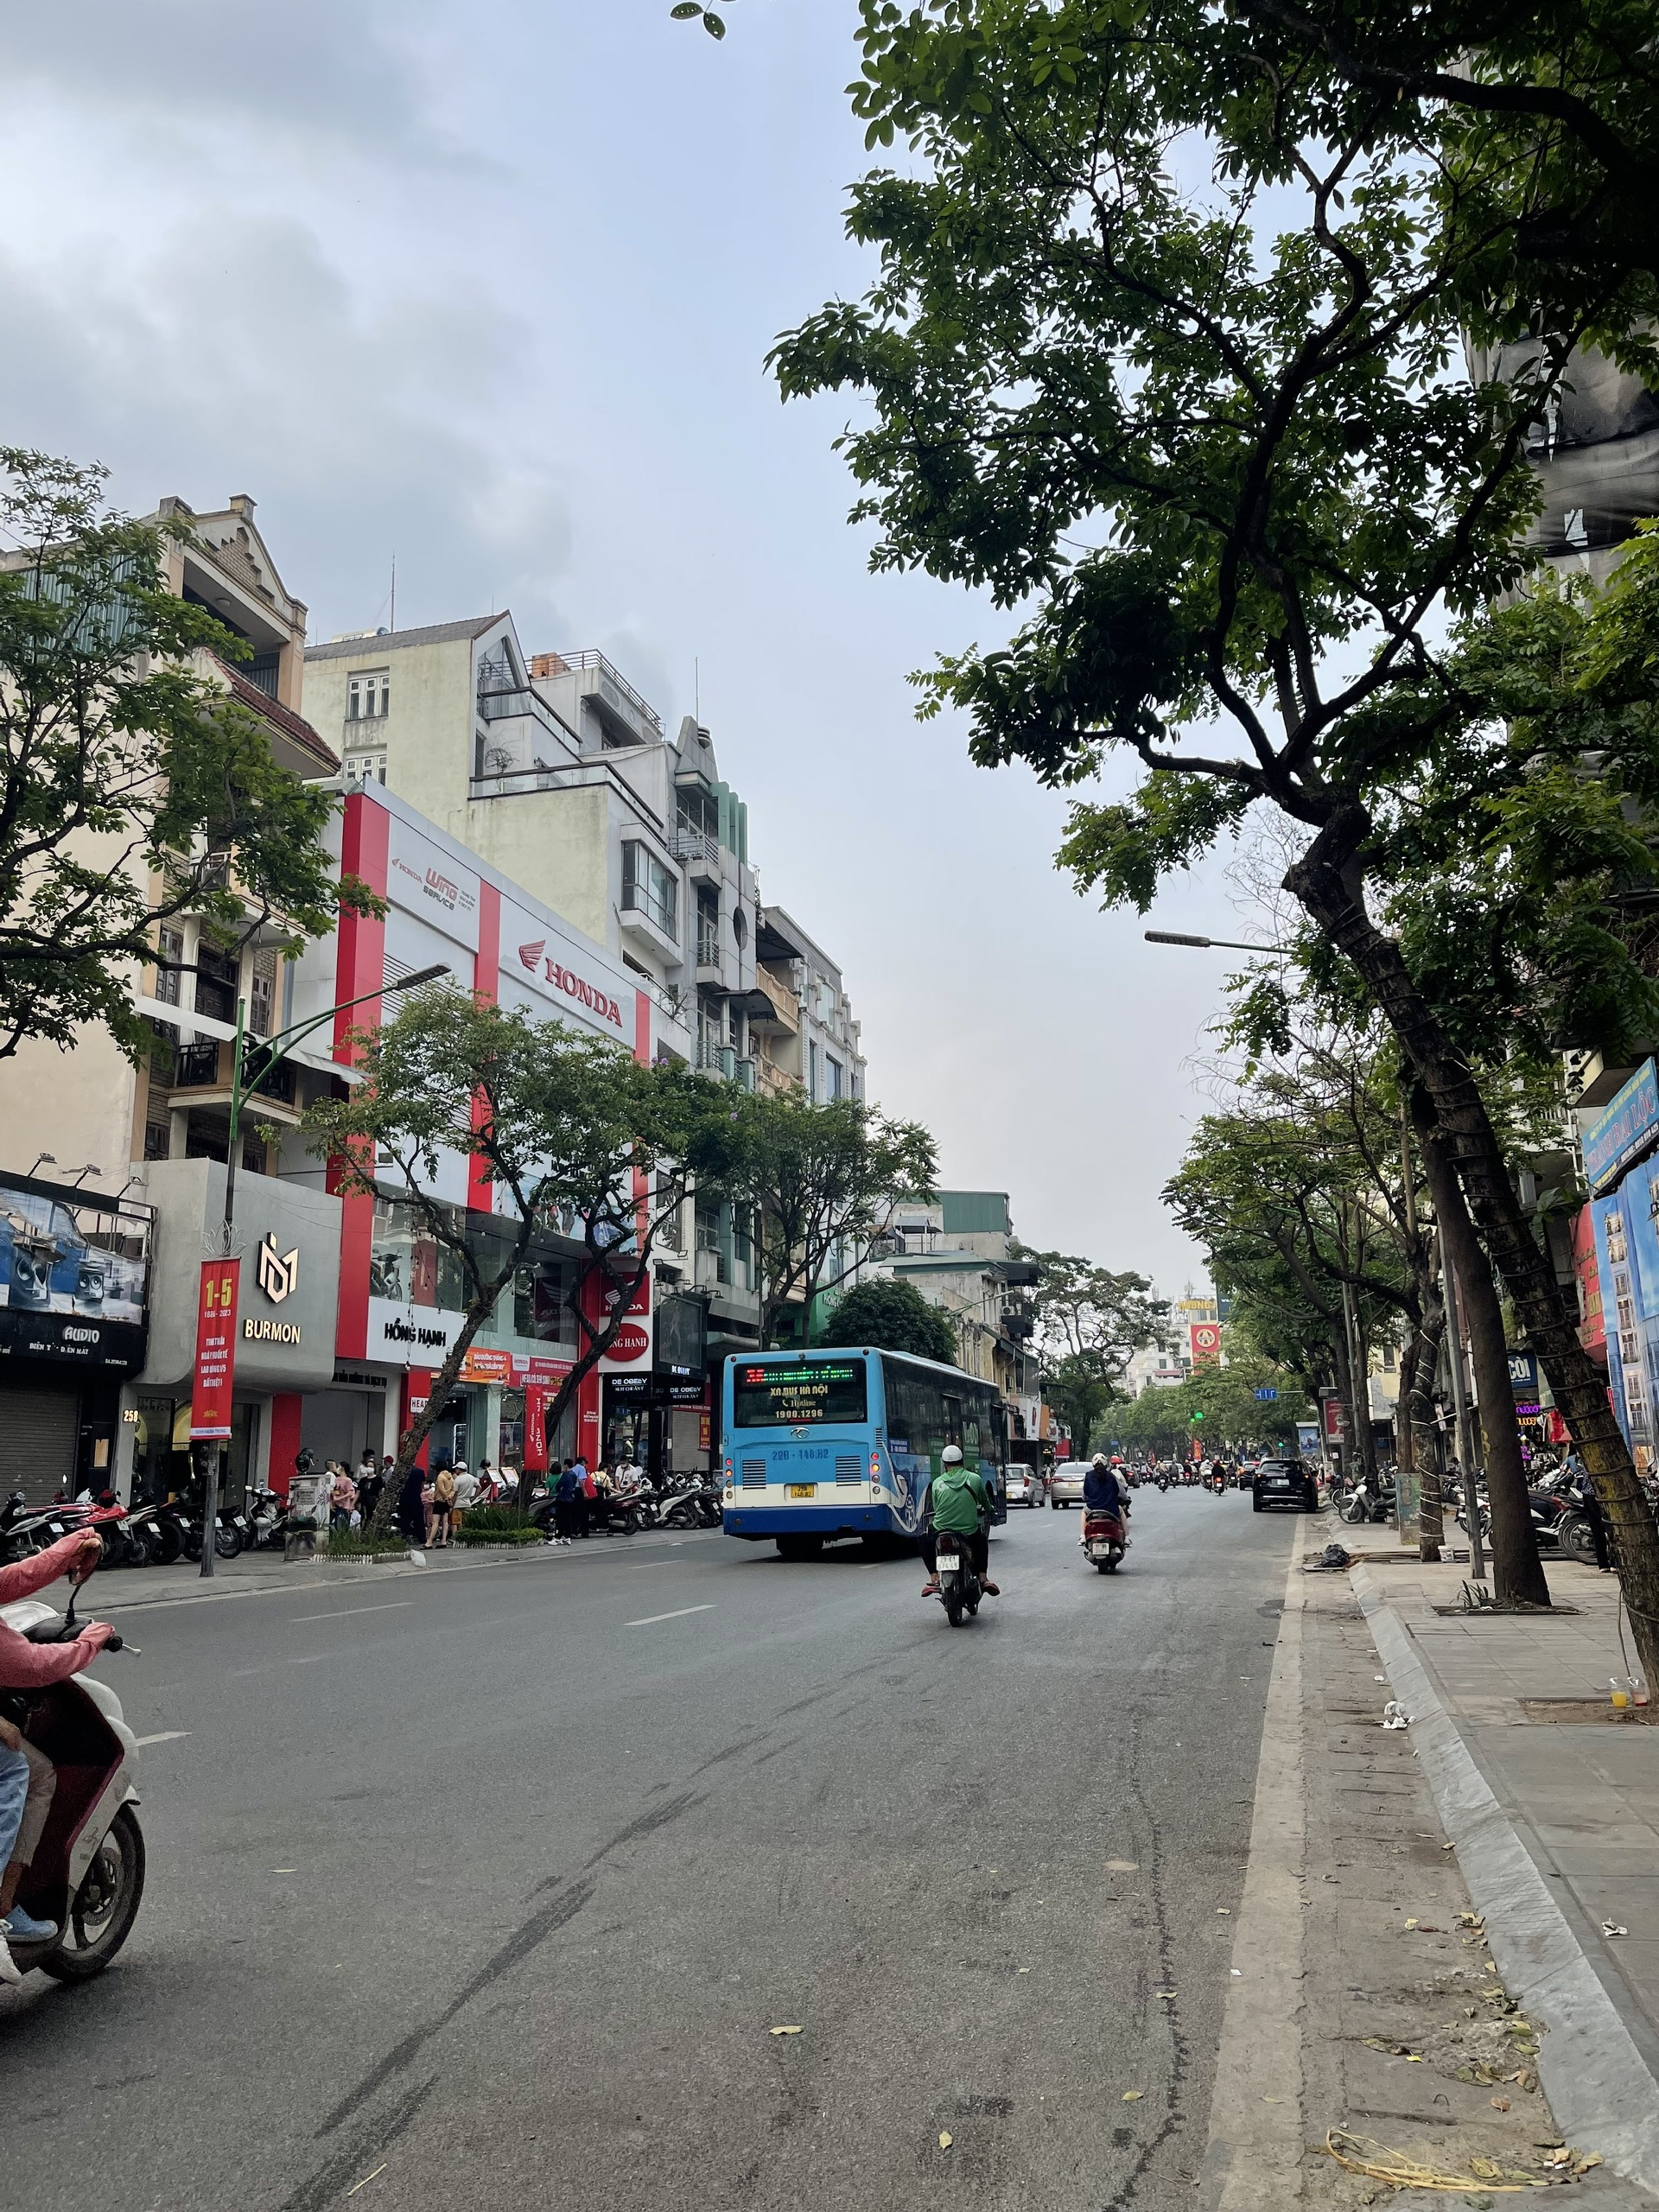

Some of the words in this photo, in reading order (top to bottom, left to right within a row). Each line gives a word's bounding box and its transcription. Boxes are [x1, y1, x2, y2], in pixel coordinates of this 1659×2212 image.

[399, 863, 423, 883] HONDA
[423, 886, 454, 911] SERVICE
[545, 957, 622, 1028] HONDA
[1631, 1086, 1656, 1128] LỘC
[206, 1278, 232, 1307] 1-5
[63, 1326, 100, 1344] AUDIO
[245, 1319, 302, 1344] BURMON
[385, 1318, 416, 1342] HỒNG
[418, 1328, 446, 1349] HẠNH
[625, 1338, 646, 1350] HẠNH
[799, 1384, 810, 1395] HÀ
[811, 1383, 829, 1396] NỘI
[124, 1410, 138, 1422] 258
[775, 1408, 823, 1419] 1900.1296
